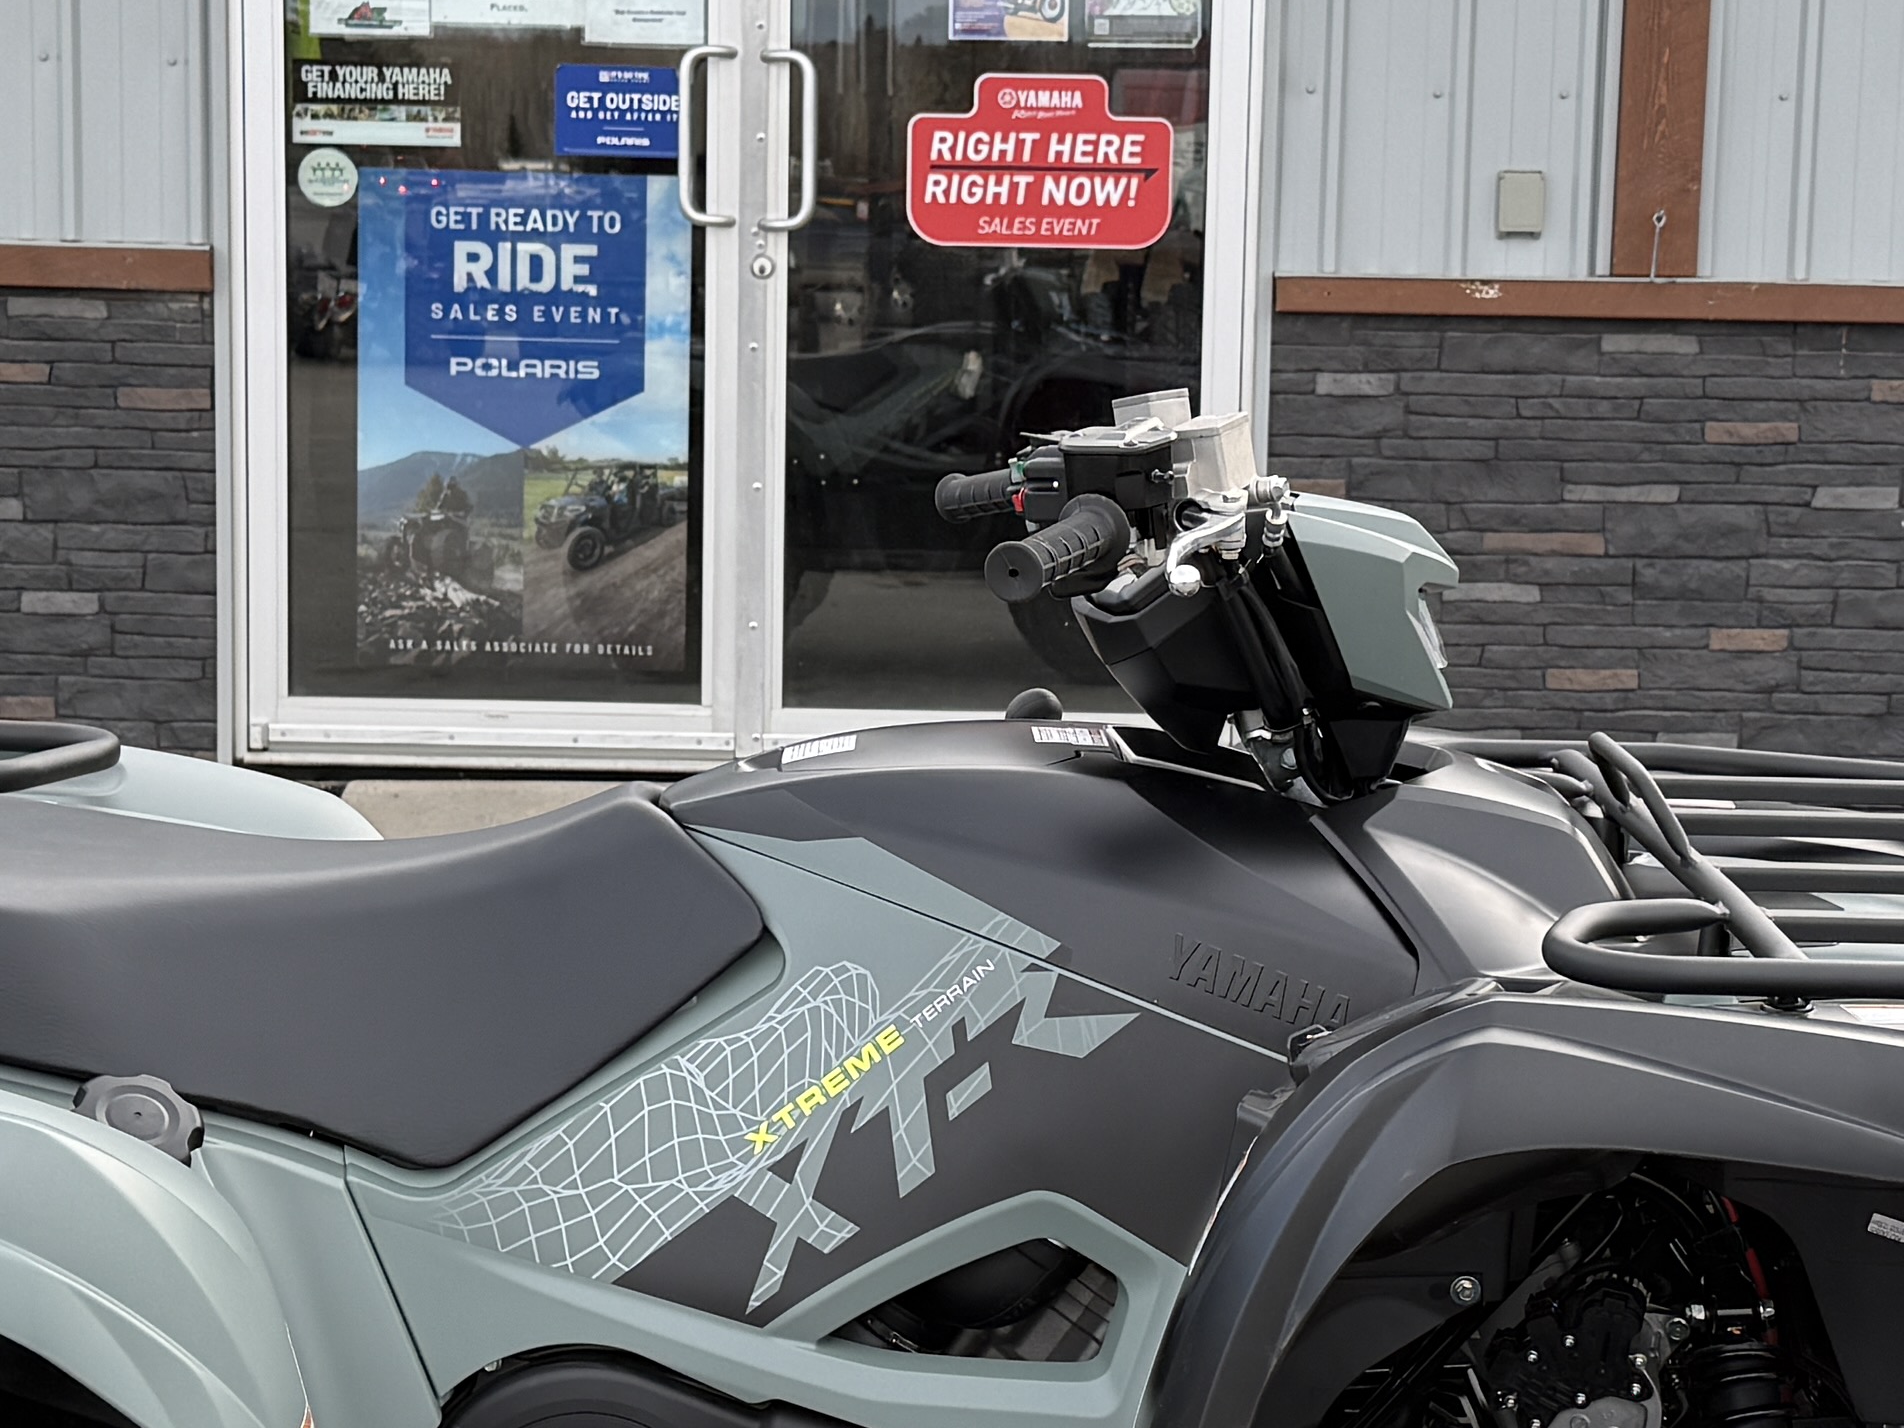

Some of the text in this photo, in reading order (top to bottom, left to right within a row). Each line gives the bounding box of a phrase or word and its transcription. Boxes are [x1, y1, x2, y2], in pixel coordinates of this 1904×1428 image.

[301, 65, 452, 85] GET YOUR YAMAHA
[307, 82, 445, 100] FINANCING HERE!
[566, 91, 680, 111] GET OUTSIDE
[1017, 90, 1083, 108] YAMAHA
[570, 110, 592, 119] AND
[930, 131, 1145, 164] RIGHT HERE
[924, 175, 1139, 208] RIGHT NOW!
[430, 206, 621, 234] GET READY TO
[978, 217, 1100, 236] SALES EVENT
[453, 240, 598, 297] RIDE
[431, 303, 620, 325] SALES EVENT
[450, 357, 600, 379] POLARIS
[389, 639, 653, 656] ASK A SALES ASSOCIATE FOR DETAILS
[1169, 932, 1351, 1025] YAMAHA
[911, 958, 998, 1028] TERRAIN
[744, 1024, 905, 1155] XTREME
